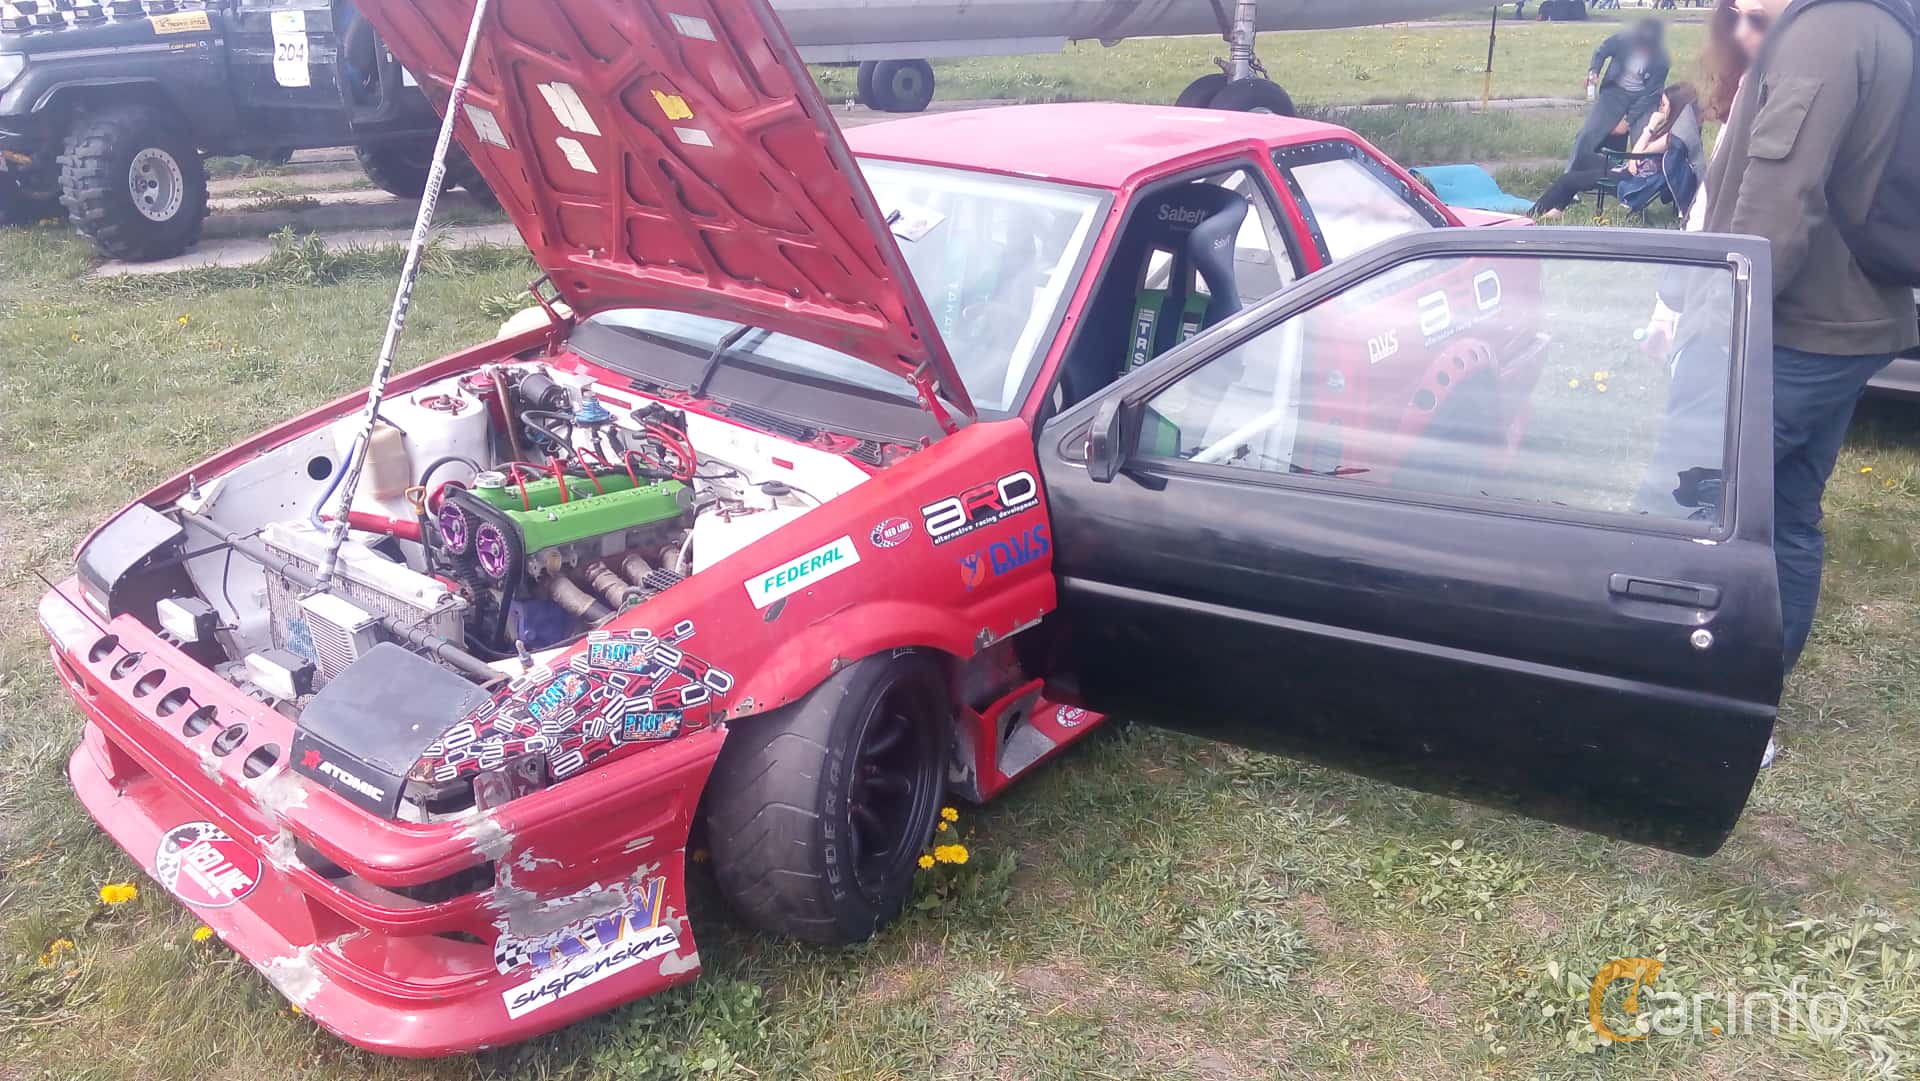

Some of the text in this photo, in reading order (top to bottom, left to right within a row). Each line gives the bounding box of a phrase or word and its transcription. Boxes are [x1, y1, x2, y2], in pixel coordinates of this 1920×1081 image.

[278, 43, 304, 61] 204
[1133, 322, 1150, 365] TRS
[884, 521, 910, 539] RED LINE
[935, 524, 973, 544] alternative
[975, 515, 997, 528] racing
[764, 547, 844, 593] FEDERAL
[319, 761, 385, 802] ATOMIC
[824, 738, 848, 900] FEDERAL
[181, 841, 225, 872] RED
[204, 862, 254, 900] LINE
[510, 931, 677, 1010] suspensions
